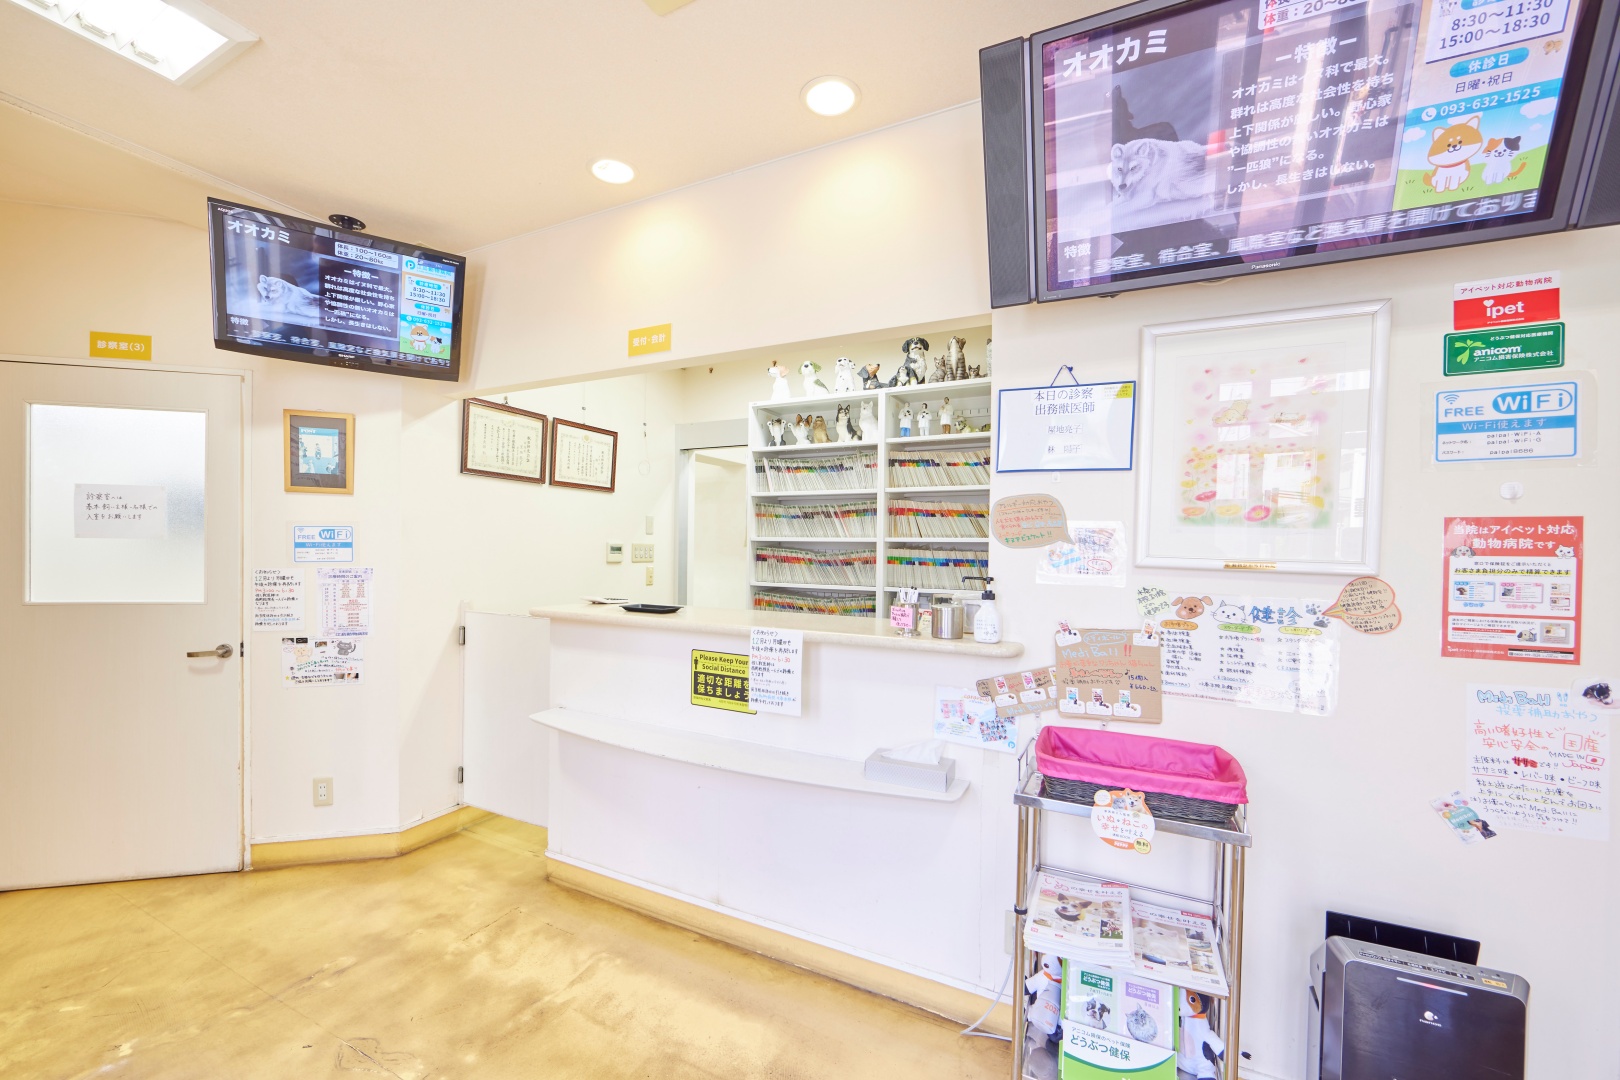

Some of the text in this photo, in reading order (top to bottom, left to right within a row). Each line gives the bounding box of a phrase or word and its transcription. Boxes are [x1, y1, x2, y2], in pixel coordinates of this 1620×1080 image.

[1439, 12, 1551, 49] 15:00～18:30
[1062, 29, 1168, 77] オオカミ
[1468, 53, 1510, 73] 休診日
[1455, 72, 1514, 94] 日曜・祝日
[1440, 86, 1541, 116] 093-632-1525
[227, 220, 291, 244] オオカミ
[1064, 243, 1091, 258] 特徴
[1251, 262, 1280, 270] Panasonic
[1460, 277, 1553, 294] アイペット対応動物病院
[1483, 299, 1524, 318] ipet
[230, 316, 248, 326] 特徴
[97, 340, 146, 352] 診察室(3)
[632, 333, 666, 348] 受付・会計
[1474, 346, 1520, 356] anicom
[1034, 387, 1094, 402] 本日の診察
[1035, 402, 1095, 416] 出務獣医師
[1444, 391, 1565, 418] FREE WiFi
[1462, 418, 1547, 431] Wi-Fi使えます
[1453, 524, 1575, 535] 当院はアイペット対応
[1472, 538, 1556, 550] 動物病院です
[1248, 605, 1303, 626] 健診
[719, 656, 734, 664] Keep
[702, 664, 720, 672] Social
[720, 666, 746, 674] Distance
[698, 674, 749, 690] 適切な距離を
[698, 684, 749, 700] 保ちましょう
[1483, 738, 1549, 750] 安心安全の
[1562, 760, 1600, 772] Japan
[1097, 814, 1148, 830] いぬ・ねこの
[1070, 1034, 1130, 1061] どうぶつ健保
